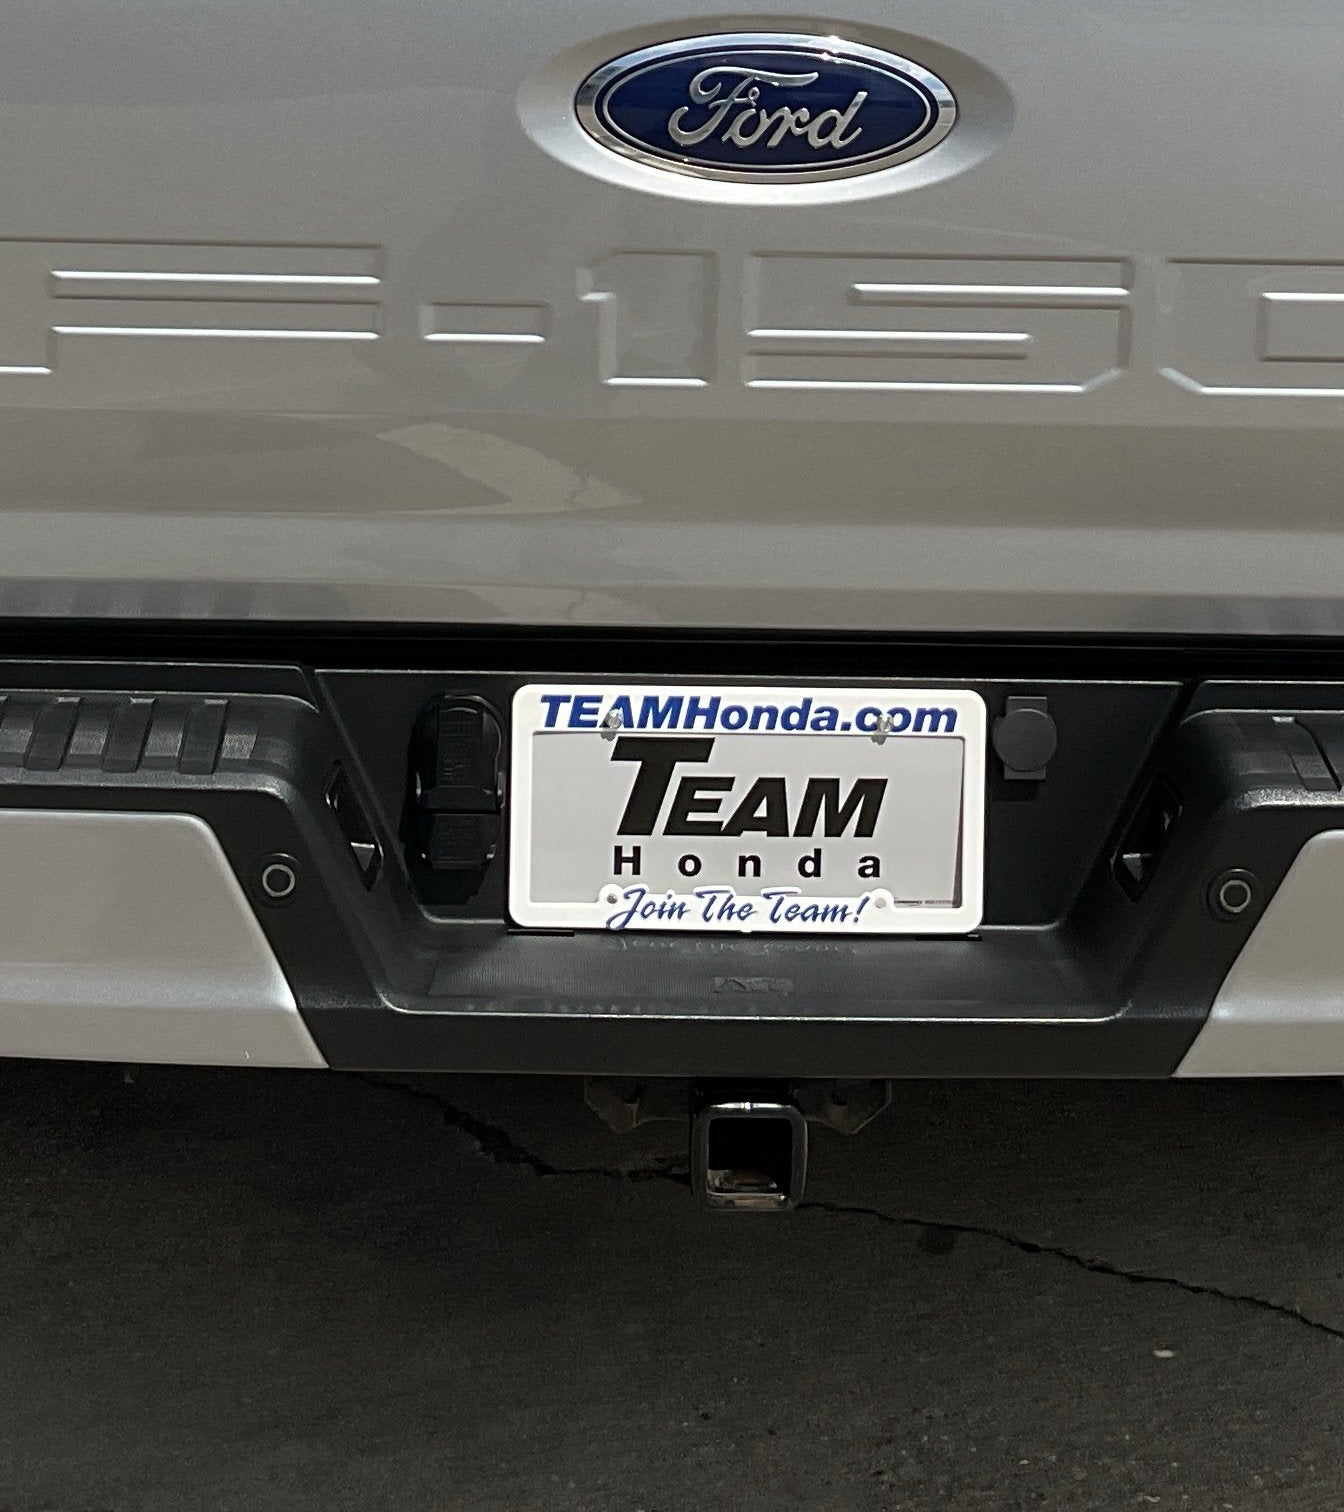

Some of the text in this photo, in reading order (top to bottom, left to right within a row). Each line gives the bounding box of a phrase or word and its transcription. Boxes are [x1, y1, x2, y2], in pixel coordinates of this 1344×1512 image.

[668, 65, 868, 149] Ford
[540, 694, 958, 733] TEAMHonda.com
[610, 736, 888, 838] TEAM
[613, 845, 882, 878] Honda
[606, 888, 867, 930] Join The Team!
